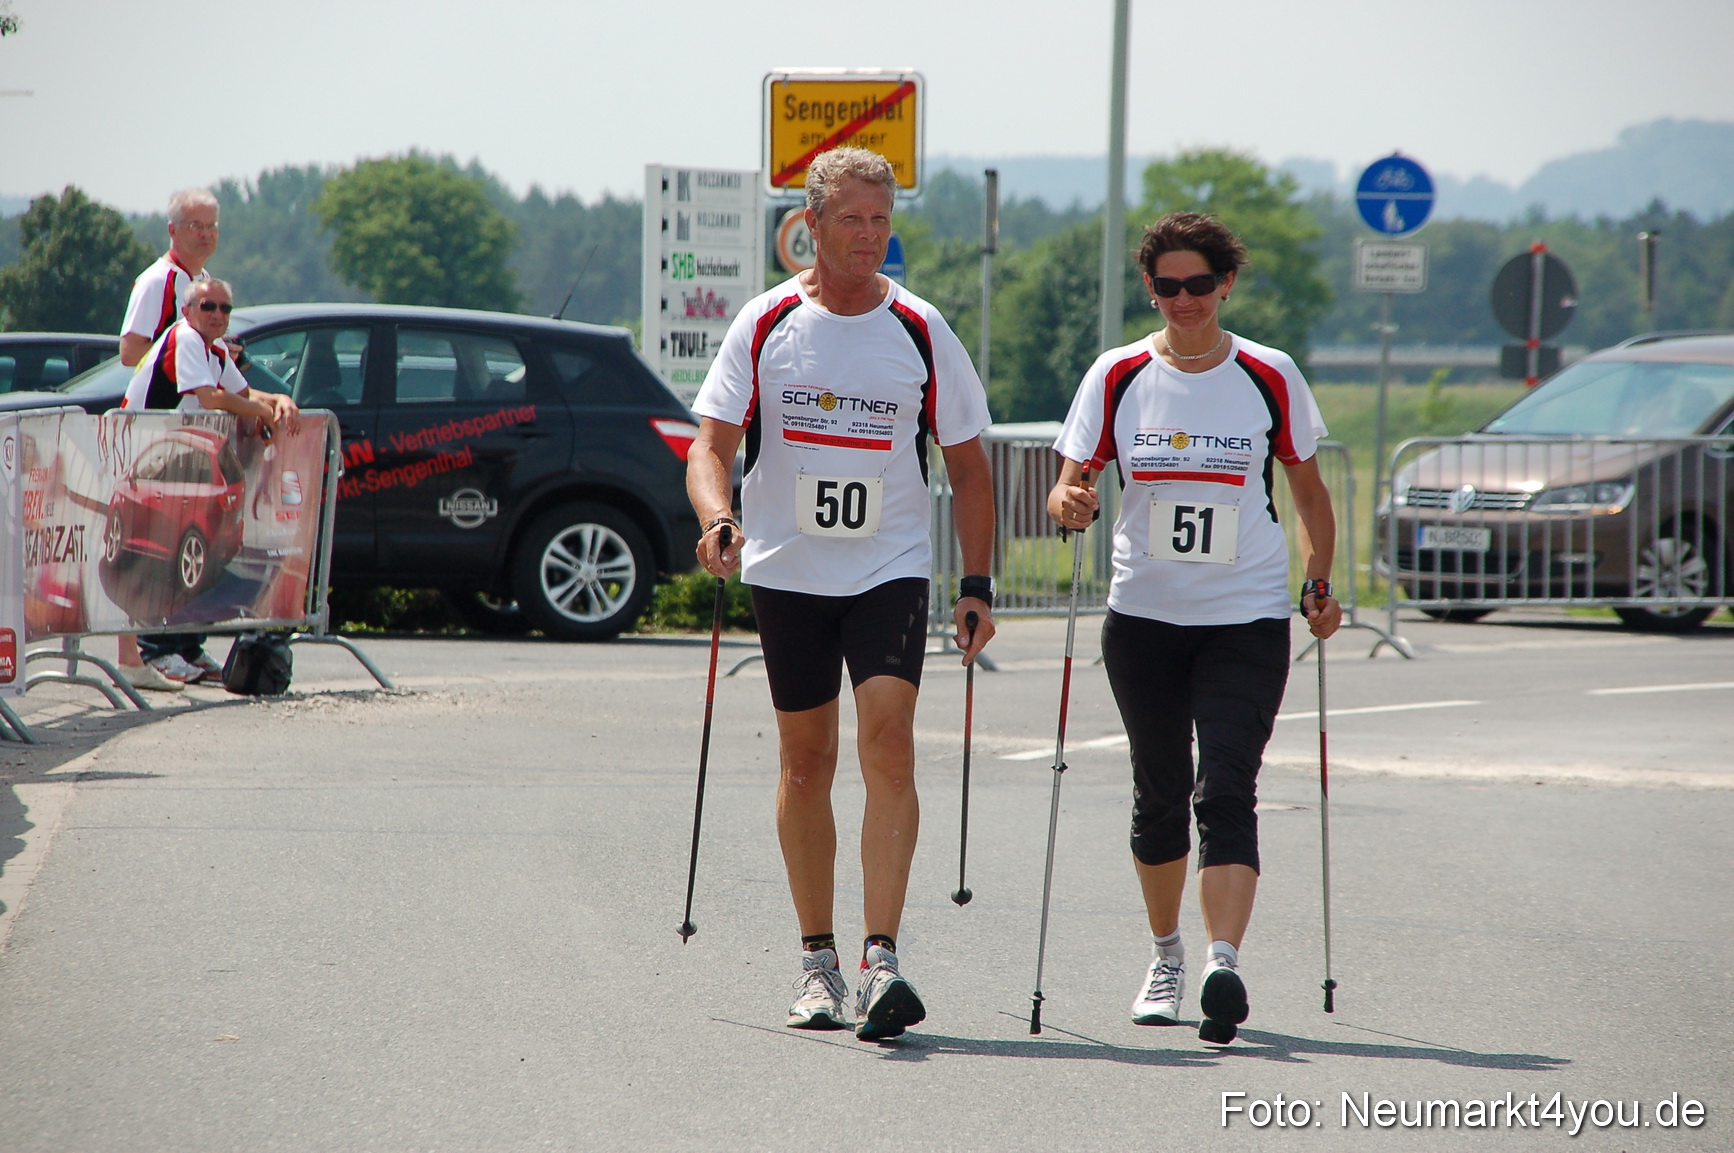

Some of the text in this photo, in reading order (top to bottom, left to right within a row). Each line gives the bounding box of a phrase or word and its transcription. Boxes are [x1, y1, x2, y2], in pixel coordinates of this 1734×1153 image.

[784, 93, 904, 127] Sengenthal
[670, 331, 708, 358] THULE
[389, 404, 537, 454] Vertriebspartner
[782, 413, 819, 424] Regensburger
[446, 500, 490, 511] NISSAN
[815, 480, 868, 530] 50
[1172, 505, 1214, 554] 51
